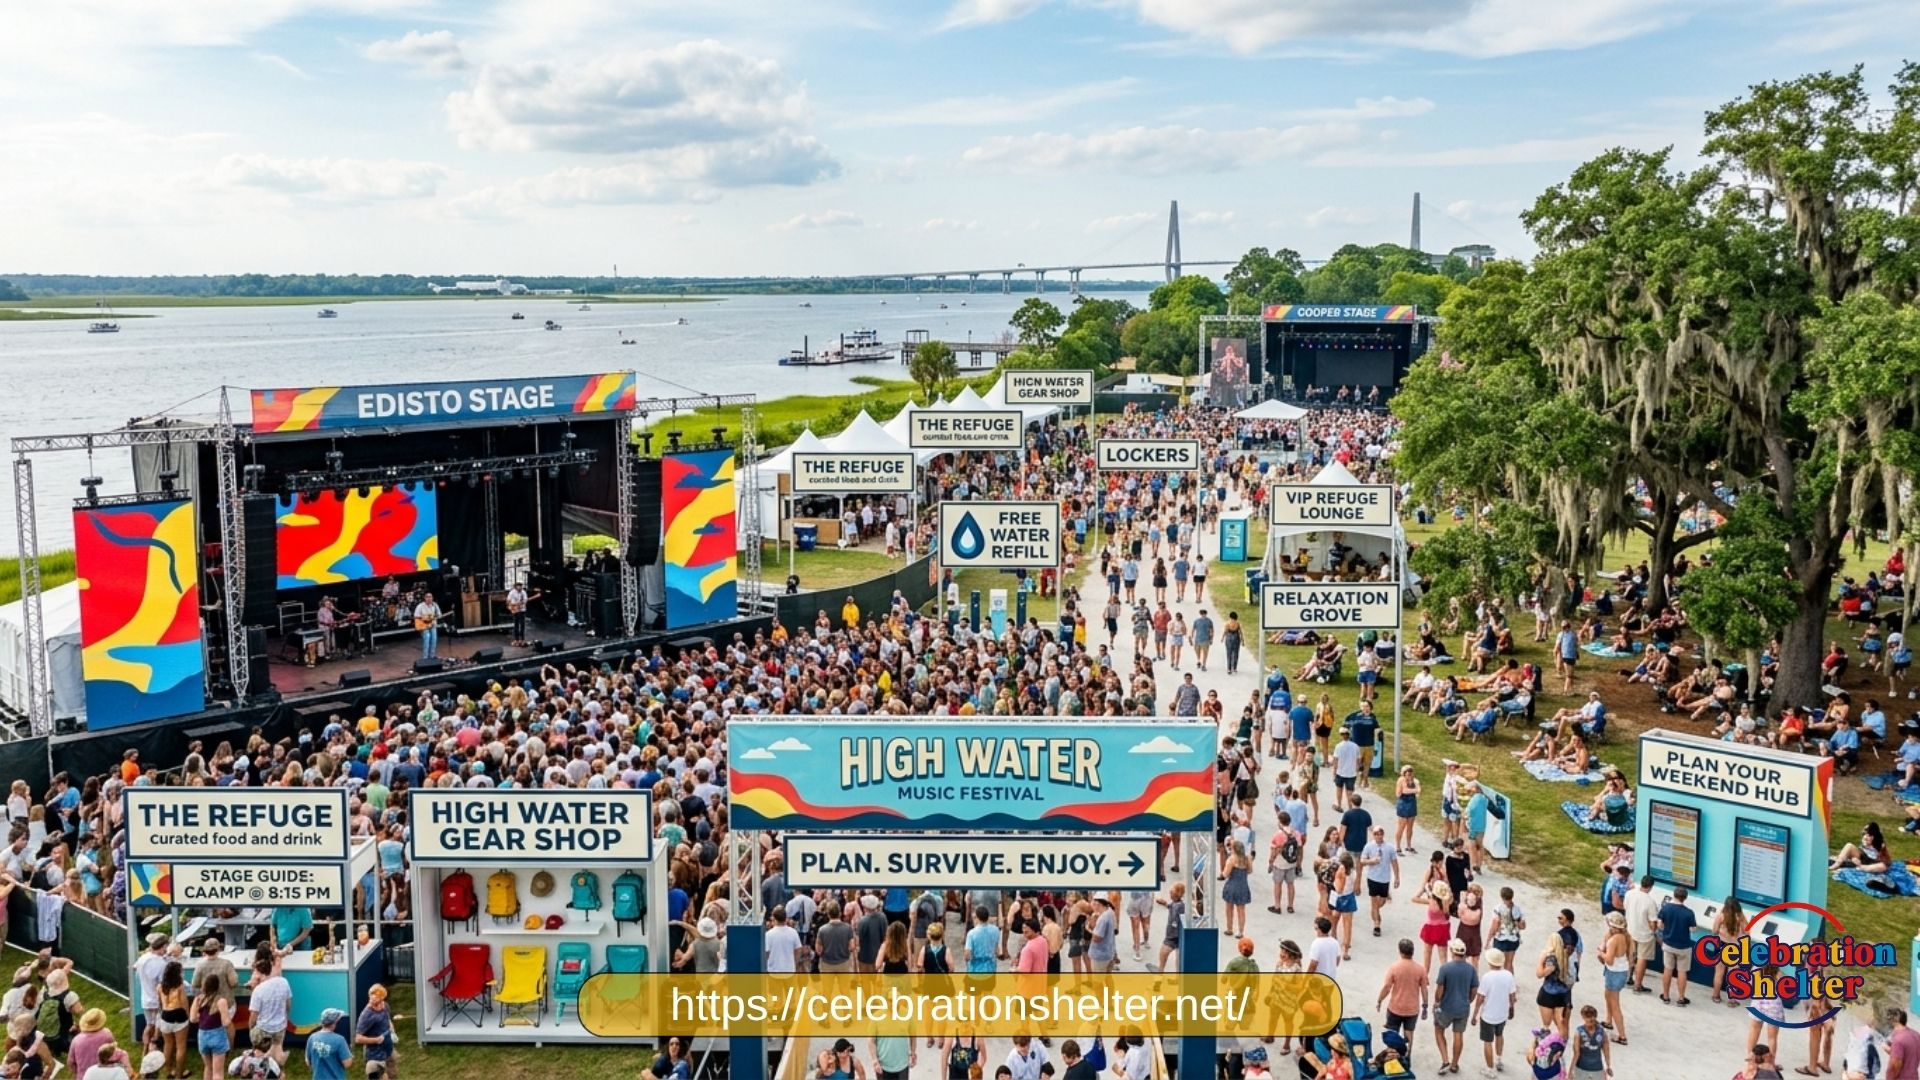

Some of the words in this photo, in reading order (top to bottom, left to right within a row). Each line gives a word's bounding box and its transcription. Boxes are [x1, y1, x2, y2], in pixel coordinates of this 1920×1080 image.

[1018, 388, 1048, 399] GEAR
[1049, 388, 1080, 398] SHOP
[358, 390, 463, 418] EDISTO
[469, 385, 555, 412] STAGE
[917, 418, 949, 431] THE
[952, 418, 1015, 431] REFUGE
[1106, 448, 1190, 462] LOCKERS
[802, 460, 836, 473] THE
[839, 460, 905, 473] REFUGE
[1285, 492, 1313, 505] VIP
[1316, 492, 1379, 505] REFUGE
[998, 512, 1041, 525] FREE
[1299, 507, 1365, 520] LOUNGE
[990, 528, 1050, 542] WATER
[991, 545, 1050, 559] REFILL
[1273, 591, 1389, 606] RELAXATION
[1299, 608, 1363, 622] GROVE
[841, 737, 944, 789] HIGH
[956, 737, 1102, 792] WATER
[1667, 751, 1719, 773] PLAN
[1725, 761, 1781, 785] YOUR
[1650, 765, 1749, 796] WEEKEND
[1755, 785, 1799, 806] HUB
[897, 786, 955, 801] MUSIC
[960, 786, 1045, 801] FESTIVAL
[137, 803, 200, 827] THE
[208, 803, 333, 828] REFUGE
[431, 801, 509, 825] HIGH
[517, 801, 629, 825] WATER
[149, 833, 209, 846] curated
[212, 832, 248, 845] food
[250, 832, 279, 846] and
[282, 832, 323, 846] drink
[439, 827, 526, 851] GEAR
[534, 827, 622, 852] SHOP
[800, 852, 881, 874] PLAN.
[887, 852, 1013, 875] SURVIVE.
[1020, 853, 1111, 875] ENJOY.
[200, 869, 254, 883] STAGE
[257, 869, 314, 883] GUIDE:
[184, 886, 245, 899] CAAMP
[268, 886, 301, 899] 8:15
[305, 886, 331, 899] PM
